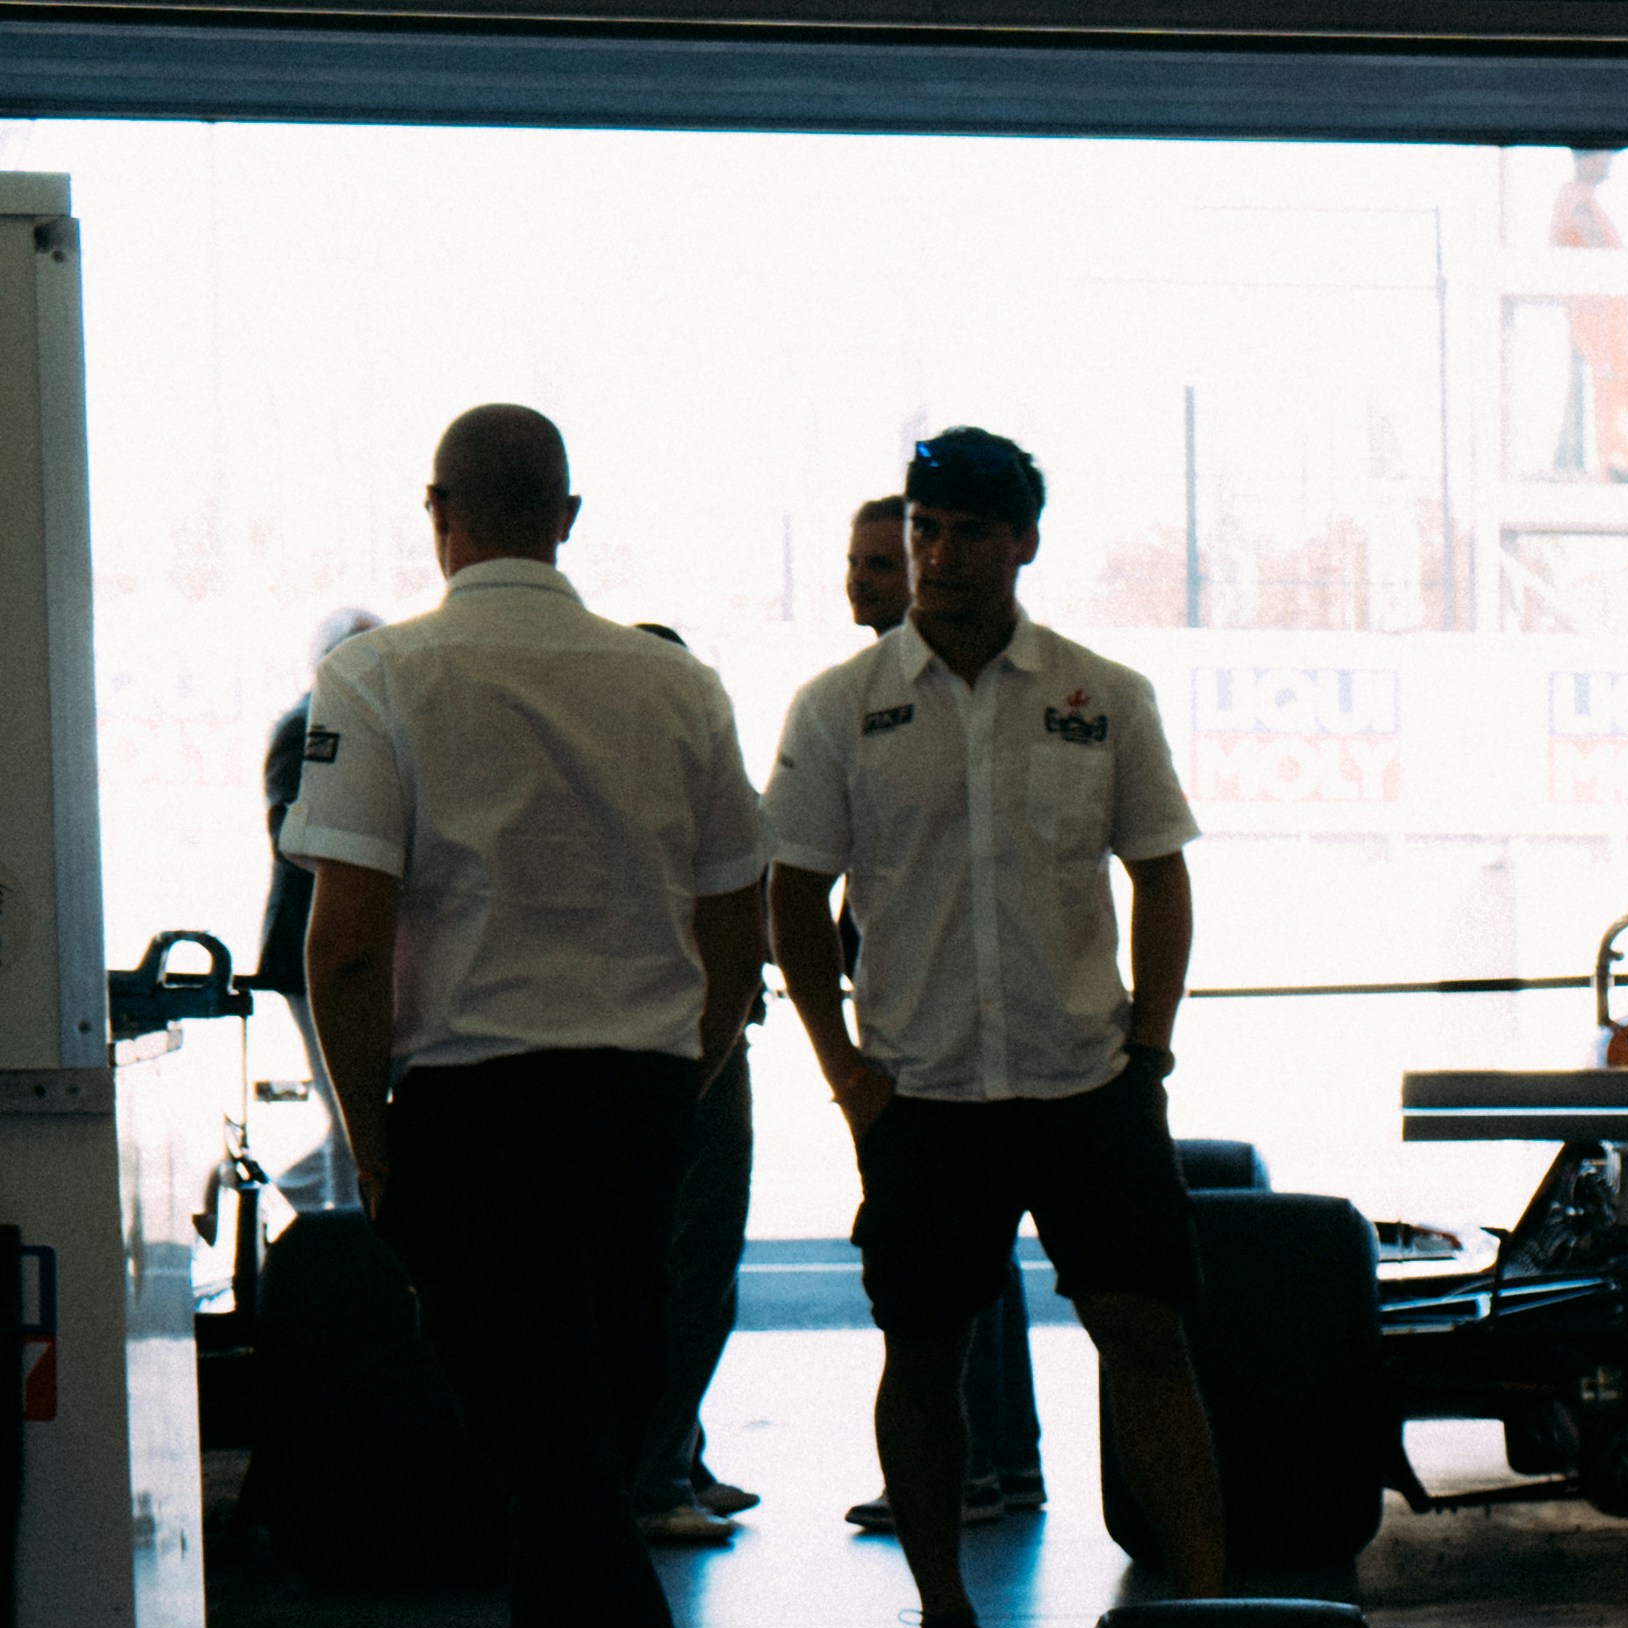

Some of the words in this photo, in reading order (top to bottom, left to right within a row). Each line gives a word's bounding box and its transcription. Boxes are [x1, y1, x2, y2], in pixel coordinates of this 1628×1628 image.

[1196, 668, 1396, 733] LIQUI
[98, 722, 242, 784] OLY
[1197, 738, 1402, 801] MOLY
